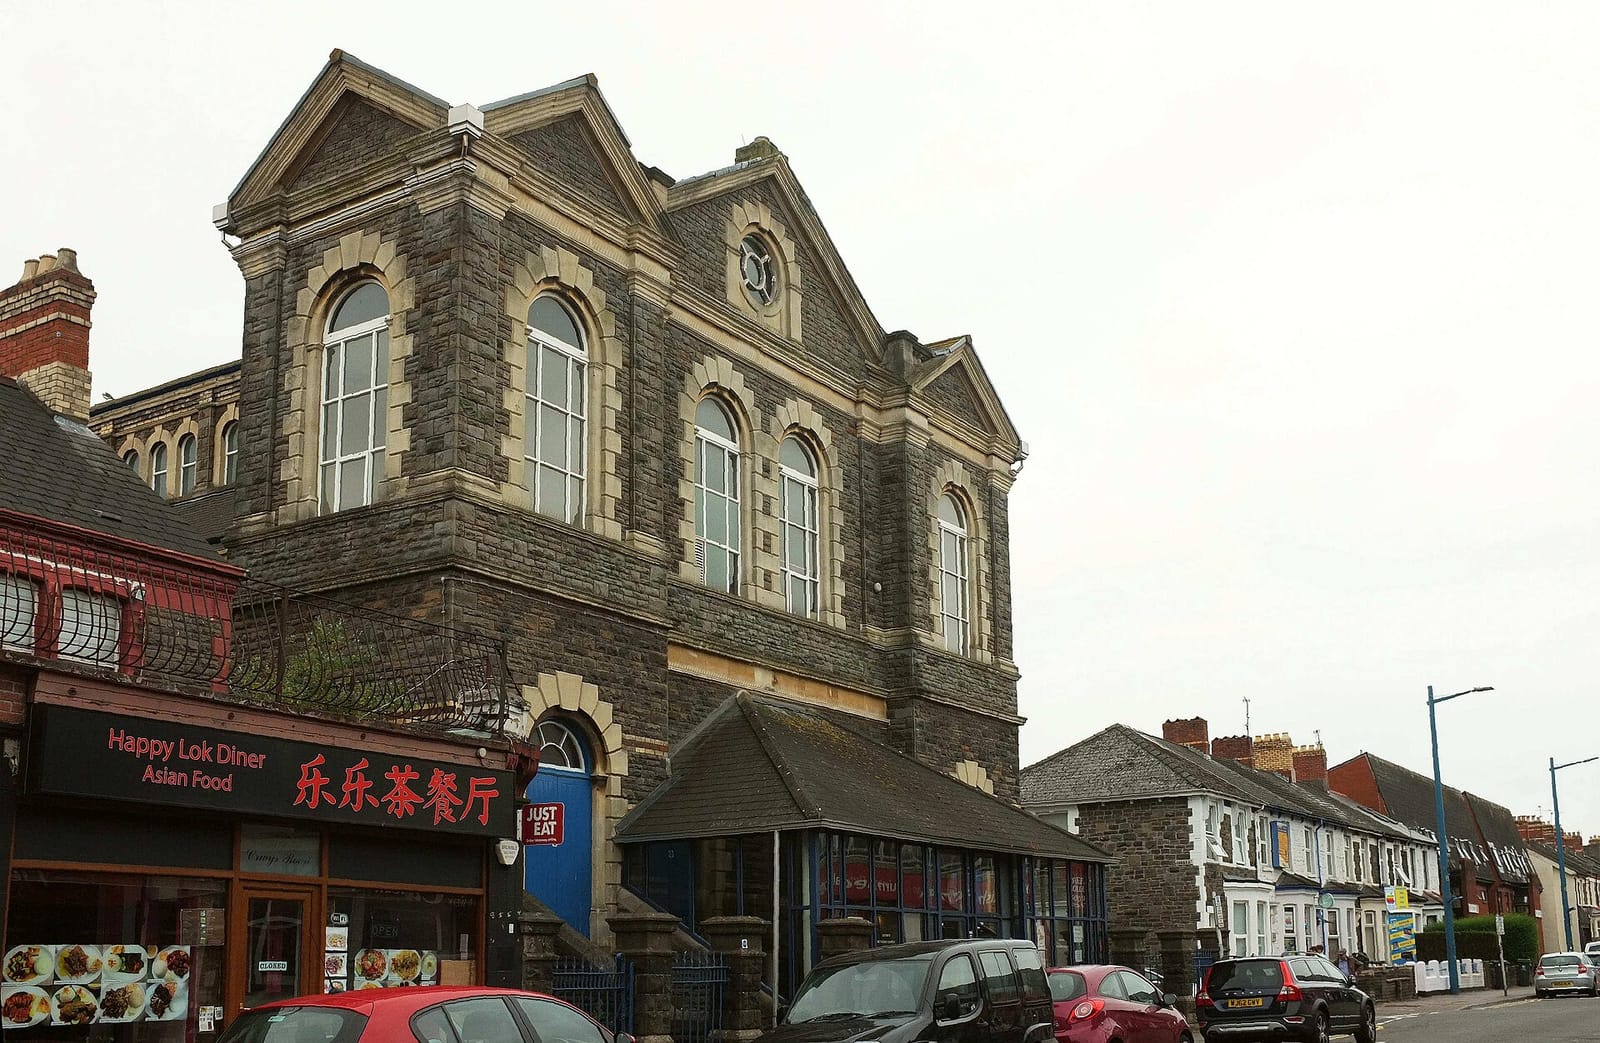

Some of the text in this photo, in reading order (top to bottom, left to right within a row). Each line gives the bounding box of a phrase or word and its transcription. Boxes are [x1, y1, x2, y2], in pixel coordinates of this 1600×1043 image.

[108, 728, 267, 769] Happy Lok Diner
[142, 765, 233, 792] Asian Food
[292, 753, 500, 826] 乐乐茶餐厅
[526, 806, 557, 822] JUST
[533, 821, 557, 836] EAT
[373, 926, 399, 937] OPEN
[259, 962, 286, 970] CLOSED
